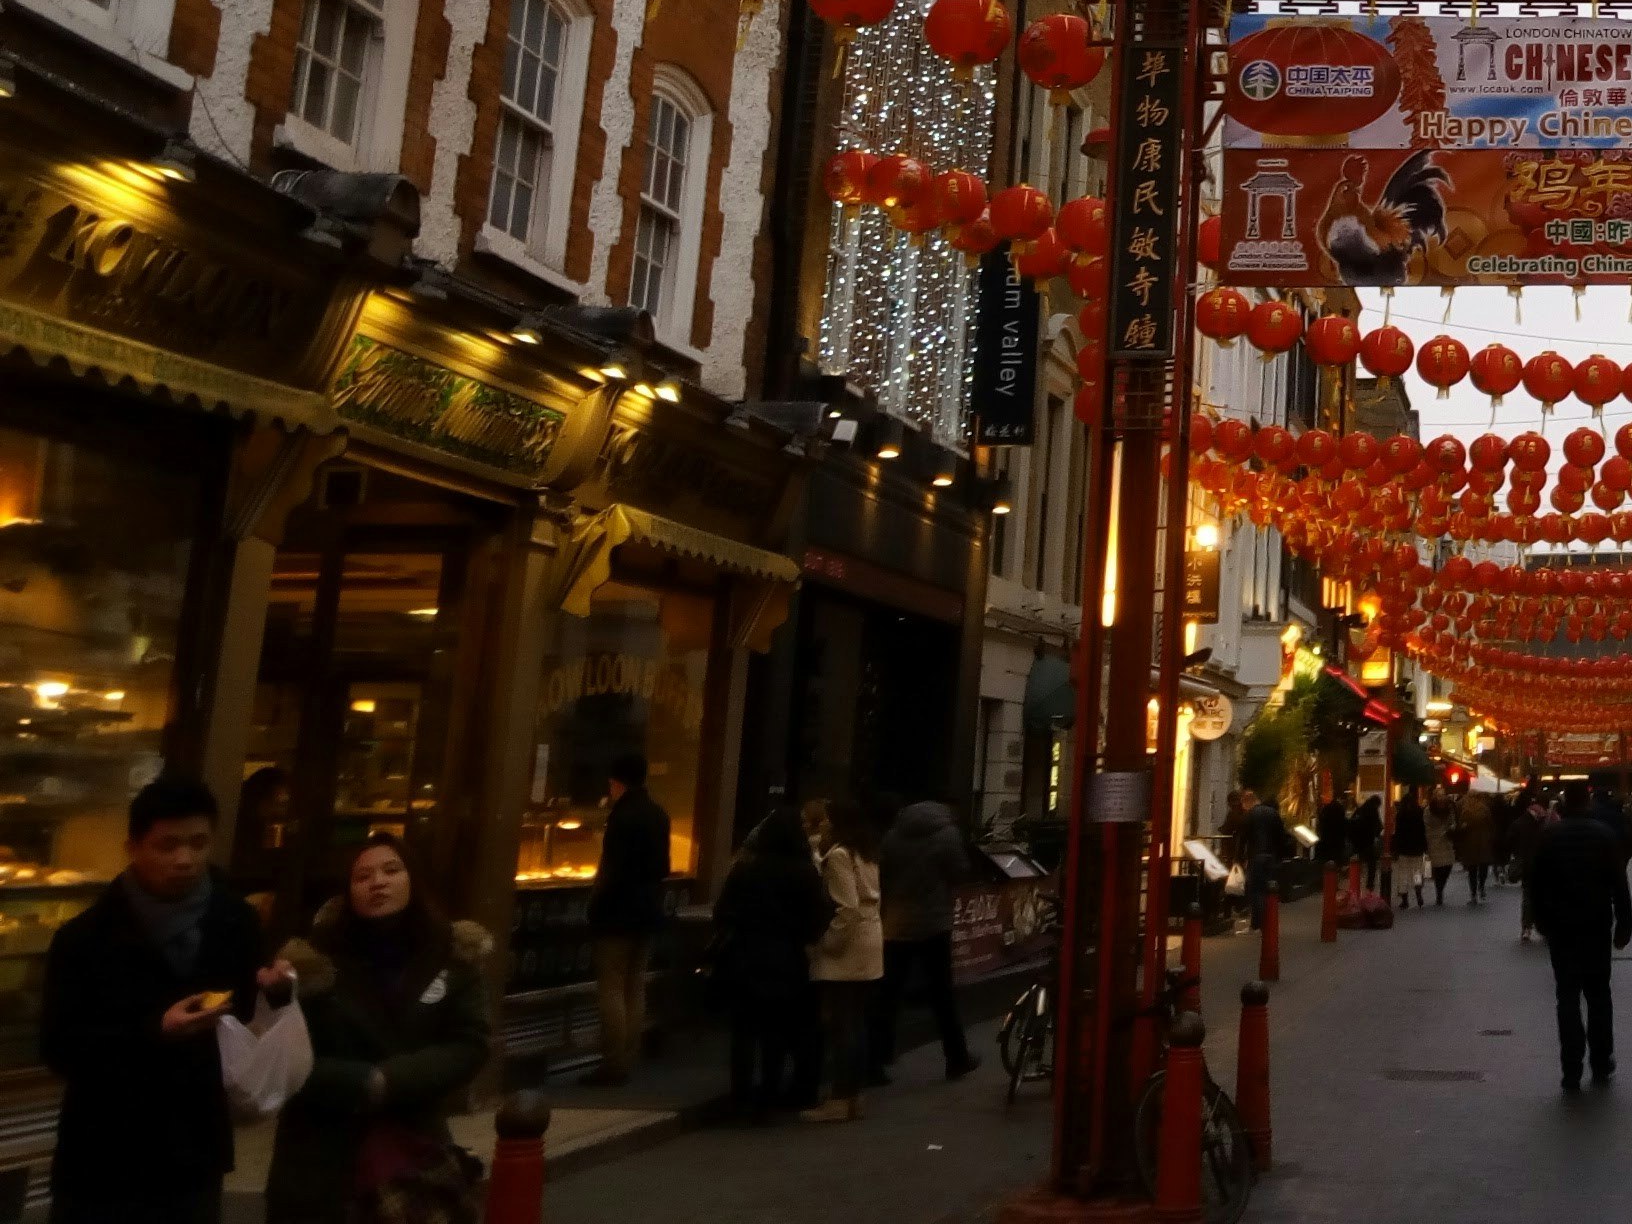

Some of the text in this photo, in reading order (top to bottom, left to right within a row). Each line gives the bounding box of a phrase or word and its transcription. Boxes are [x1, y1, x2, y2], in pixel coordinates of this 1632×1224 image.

[1506, 28, 1560, 39] LONDON
[1504, 43, 1632, 81] CHINESE
[1287, 66, 1373, 85] 中国太平
[1287, 87, 1373, 96] CHINA TAIPING
[1420, 111, 1528, 144] Happy
[1467, 256, 1577, 275] Celebrating
[994, 319, 1024, 398] valley
